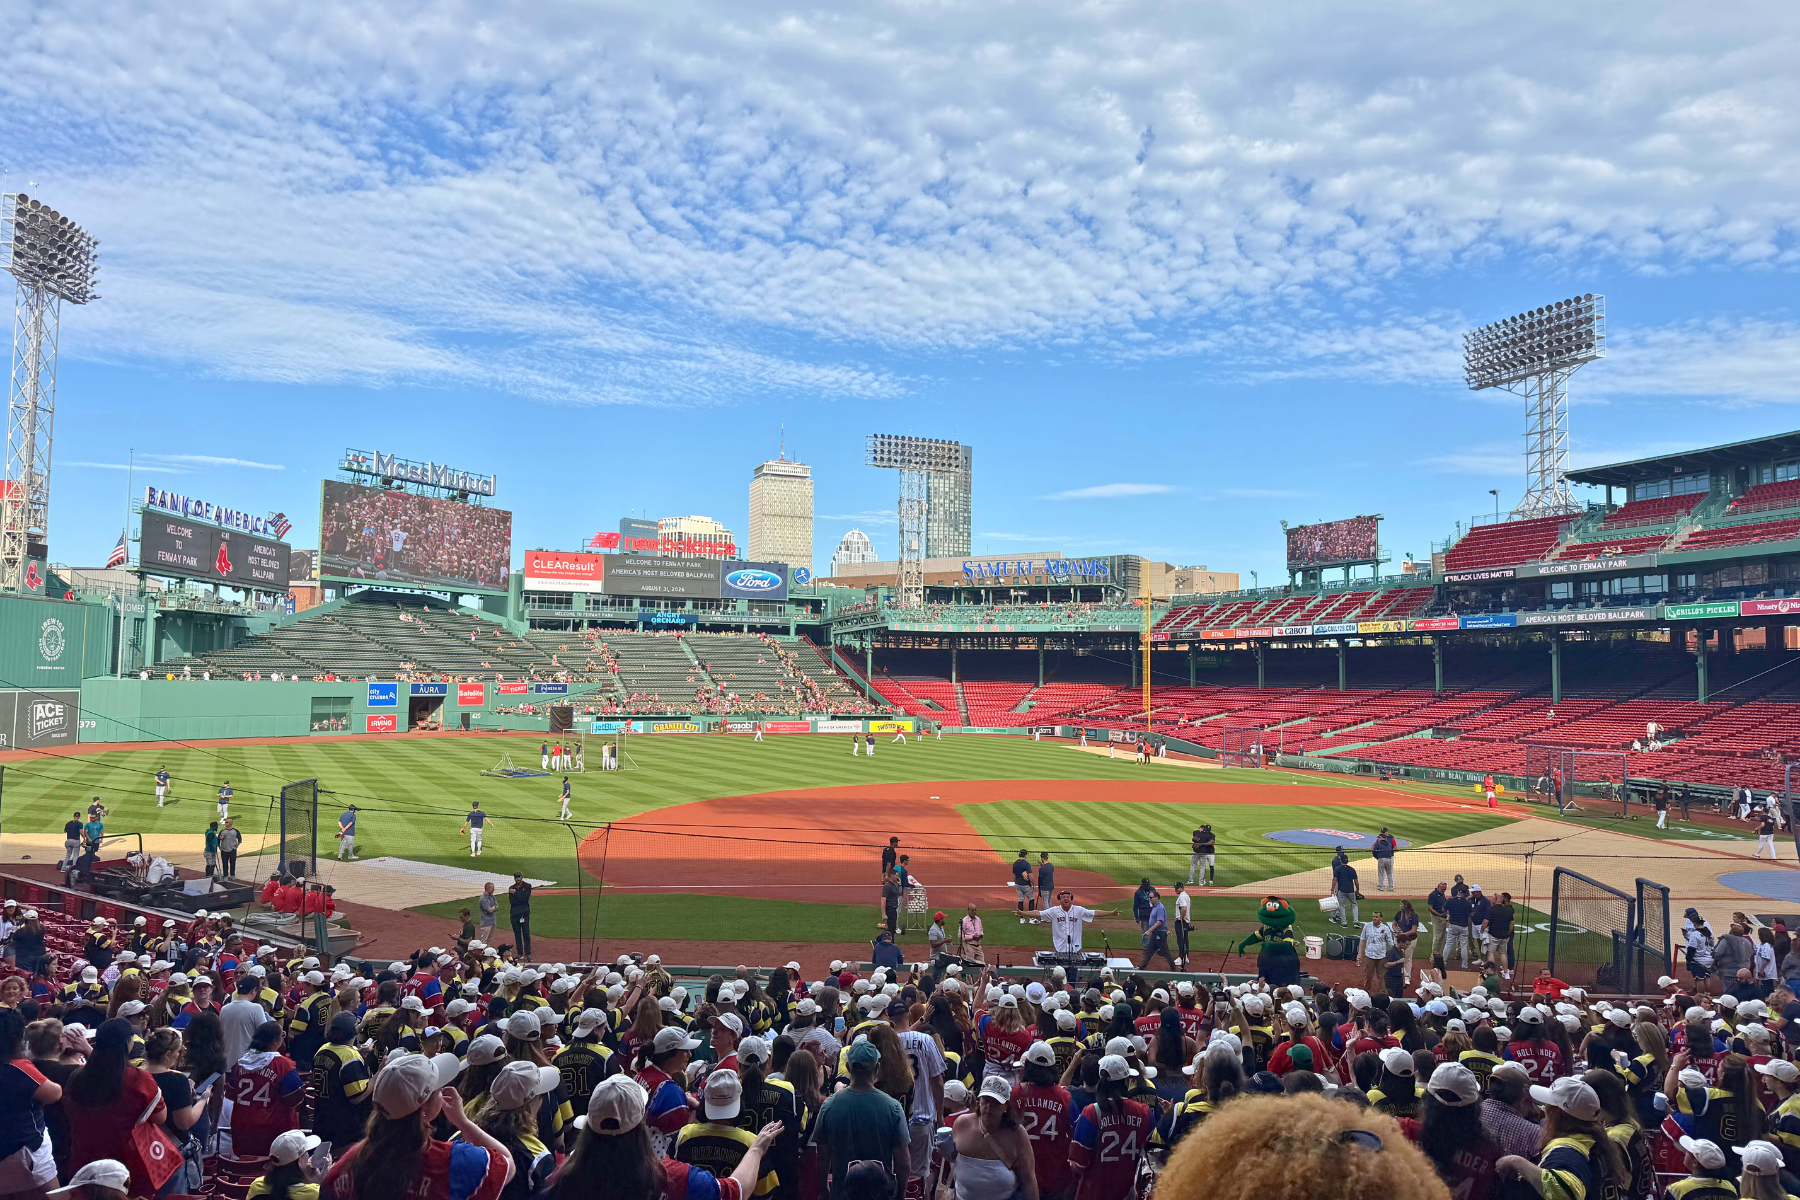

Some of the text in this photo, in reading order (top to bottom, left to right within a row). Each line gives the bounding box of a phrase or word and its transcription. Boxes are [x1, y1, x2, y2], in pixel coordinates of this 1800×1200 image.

[374, 450, 497, 496] MassMutual
[145, 486, 269, 534] BANK OF AMERICA
[166, 523, 193, 539] WELCOME
[175, 539, 183, 550] TO
[253, 544, 276, 557] AMERICA'S
[624, 535, 737, 556] new balance
[157, 550, 198, 567] FENWAY PARK
[247, 556, 280, 570] MOST BELOVED
[533, 560, 595, 571] CLEAResult
[611, 568, 642, 576] AMERICA'S
[962, 557, 1110, 581] SAMUEL ADAMS
[1538, 564, 1568, 574] WELCOME
[1579, 561, 1606, 571] FENWAY
[1608, 560, 1628, 568] PARK
[252, 568, 275, 581] BALLPARK
[737, 572, 771, 588] Ford
[1453, 570, 1514, 582] BLACK LIVES MATTER
[115, 602, 145, 613] AIOMED
[1676, 605, 1736, 616] GRILLO'S PICKLES
[1757, 603, 1778, 611] Ninety
[1525, 610, 1644, 624] AMERICA'S MOST BELOVED BALLPARK
[36, 703, 64, 720] ACE
[36, 716, 64, 731] TICKET
[80, 720, 96, 728] 379
[654, 722, 700, 732] GRANITE CITY
[878, 723, 896, 731] TWISTED
[1139, 1022, 1161, 1033] HOLLAN
[986, 1036, 1022, 1054] HOLLANDER
[1520, 1058, 1556, 1082] 24
[236, 1078, 272, 1108] 24
[1016, 1098, 1063, 1114] HLLANDER
[1023, 1111, 1058, 1142] 24
[1100, 1130, 1140, 1162] 24
